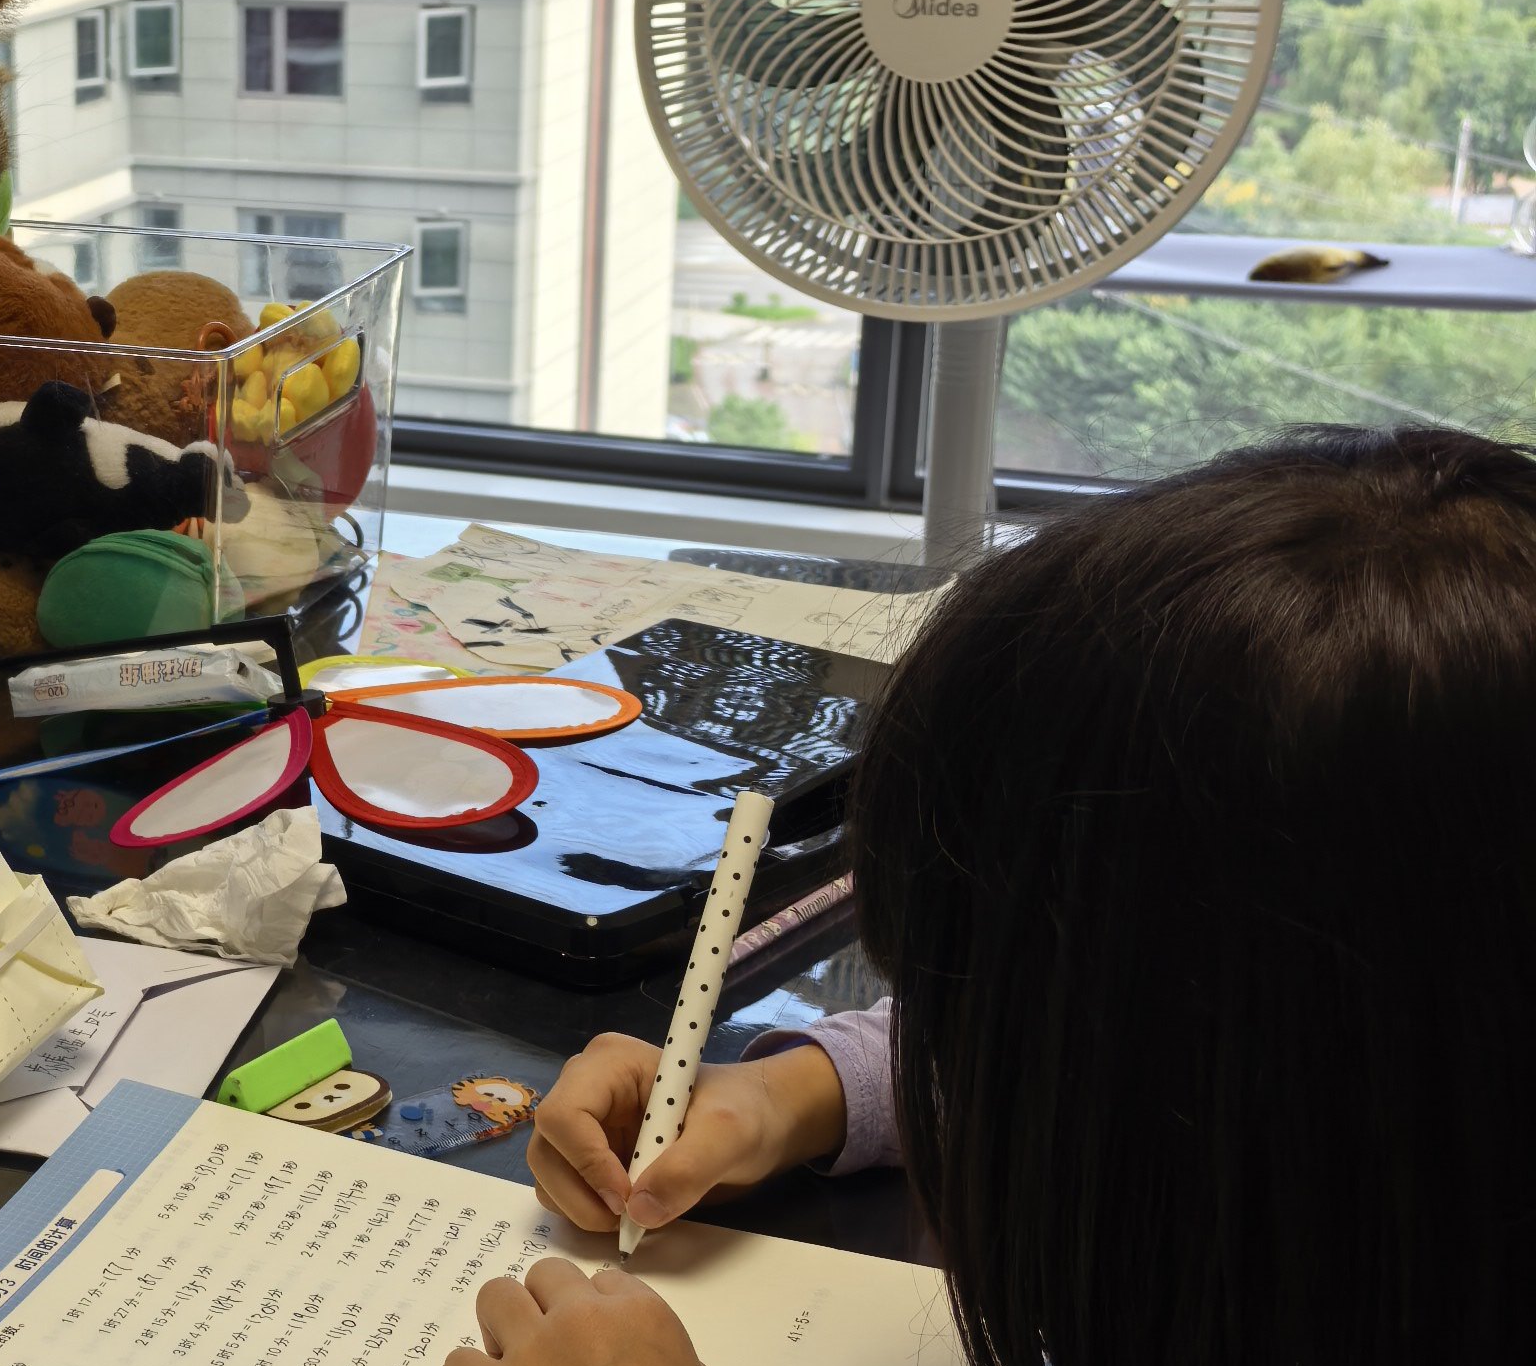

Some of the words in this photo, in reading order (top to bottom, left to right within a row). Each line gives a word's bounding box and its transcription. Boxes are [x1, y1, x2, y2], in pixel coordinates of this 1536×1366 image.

[14, 1216, 78, 1271] 时间的计算
